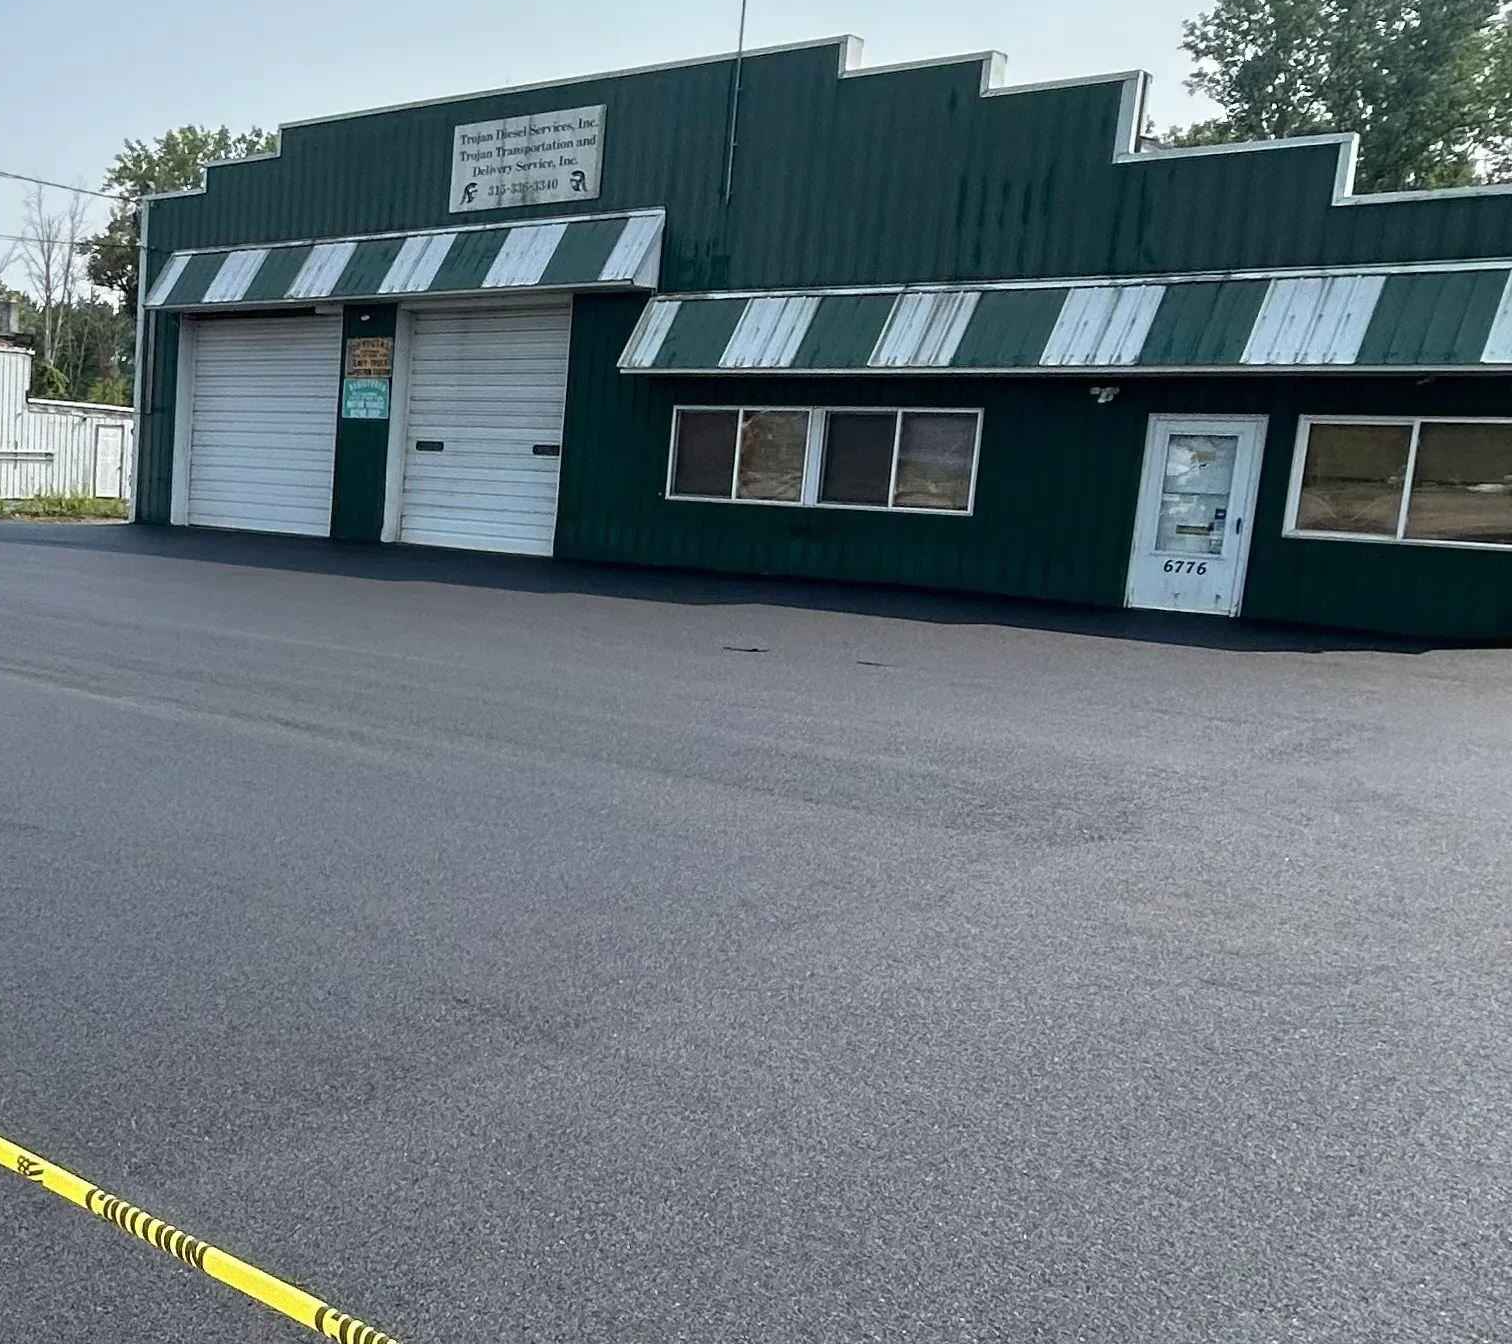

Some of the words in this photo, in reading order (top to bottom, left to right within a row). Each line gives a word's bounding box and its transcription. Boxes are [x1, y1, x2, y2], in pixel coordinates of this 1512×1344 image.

[460, 132, 493, 146] Trojan
[496, 126, 527, 141] Diesel
[529, 121, 575, 137] Services,
[578, 117, 599, 129] Inc.
[459, 150, 493, 162] Trojan
[495, 139, 574, 158] Transportation
[576, 134, 597, 146] and
[472, 163, 512, 178] Delivery
[559, 155, 579, 167] Inc.
[1163, 559, 1208, 576] 6776
